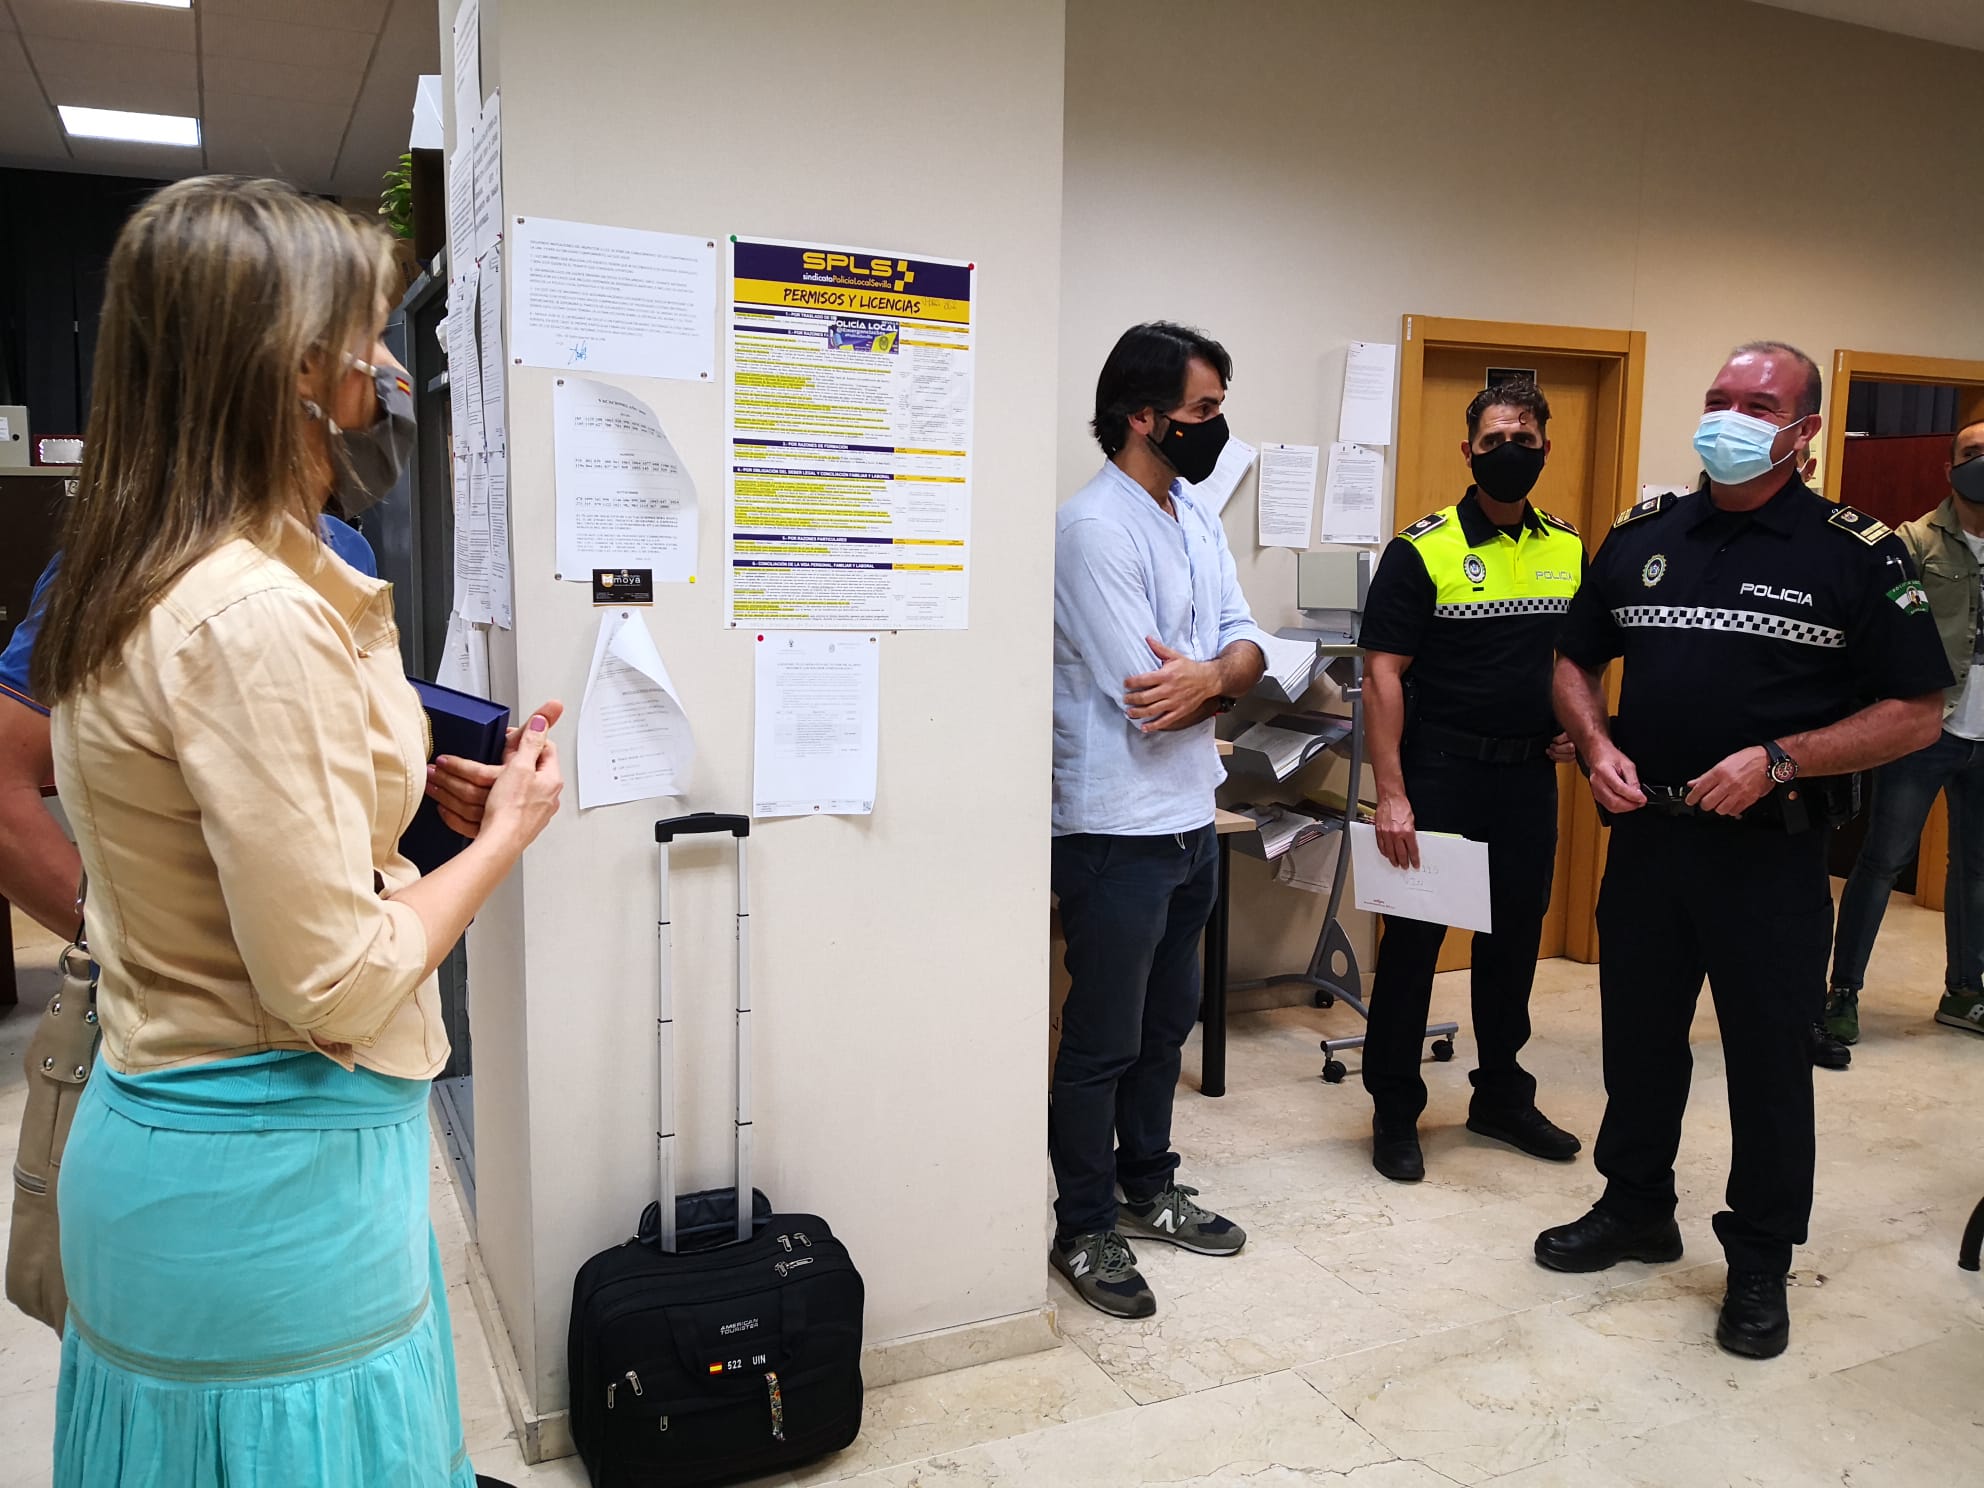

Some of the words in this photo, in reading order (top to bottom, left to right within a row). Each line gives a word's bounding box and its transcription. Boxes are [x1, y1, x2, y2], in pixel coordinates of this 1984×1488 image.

[802, 251, 893, 277] SPLS
[783, 288, 846, 306] PERMISOS
[848, 294, 857, 308] Y
[859, 296, 921, 315] LICENCIAS
[868, 322, 898, 332] LOCAL
[1739, 582, 1813, 607] POLICIA
[720, 1318, 759, 1330] AMERICAN
[720, 1323, 759, 1335] TOURISTER
[727, 1359, 743, 1370] 522
[752, 1353, 766, 1366] UIN
